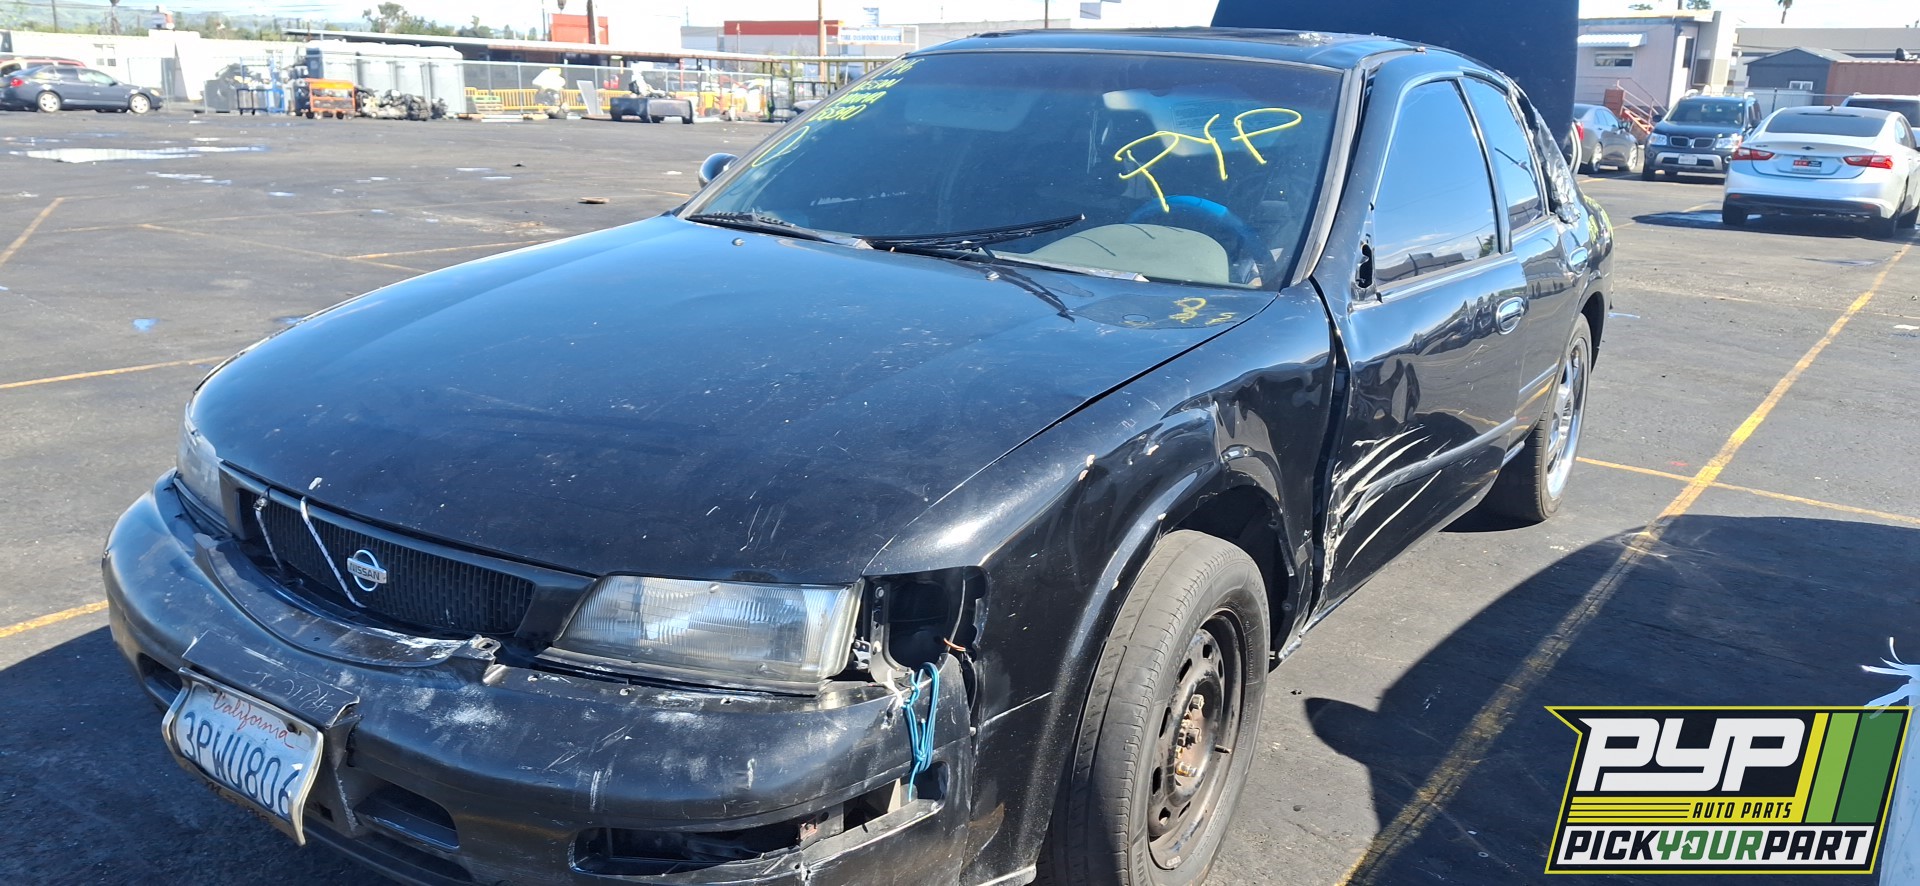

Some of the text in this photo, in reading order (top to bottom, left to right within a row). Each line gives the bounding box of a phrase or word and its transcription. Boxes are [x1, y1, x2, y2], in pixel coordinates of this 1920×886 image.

[1114, 107, 1302, 214] PYP
[349, 562, 380, 581] NISSAN
[213, 692, 295, 749] California
[182, 710, 301, 817] 3PWU806
